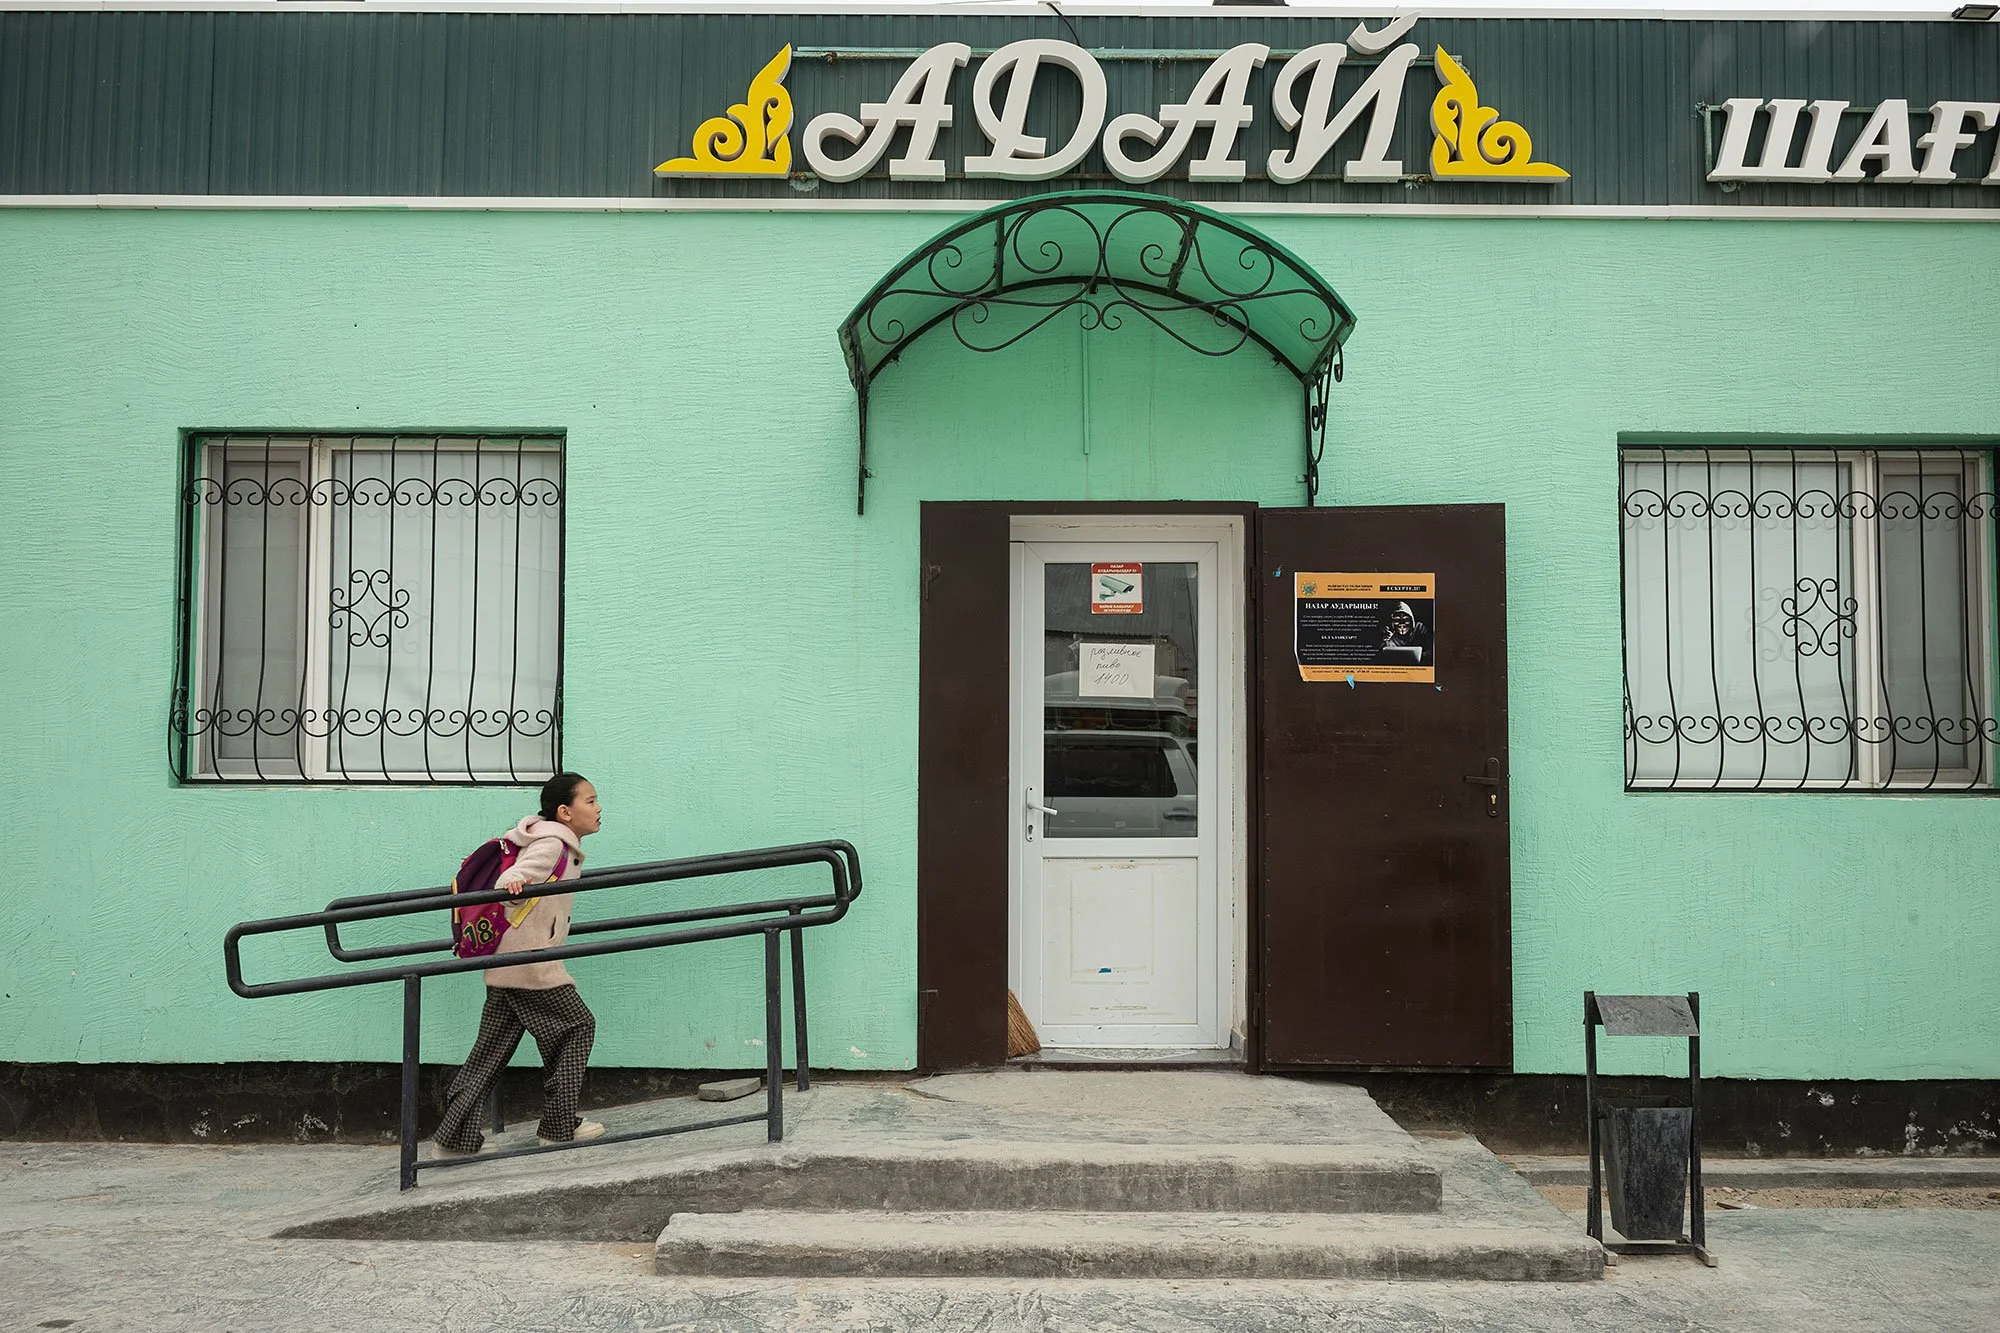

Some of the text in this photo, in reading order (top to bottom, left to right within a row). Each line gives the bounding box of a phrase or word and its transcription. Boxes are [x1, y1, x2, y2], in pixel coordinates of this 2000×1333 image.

[803, 13, 1420, 184] АДАЙ
[1706, 97, 2000, 186] ШАҒ
[1305, 602, 1330, 610] НАЗАР
[1096, 658, 1121, 670] пиво
[462, 917, 494, 948] 18
